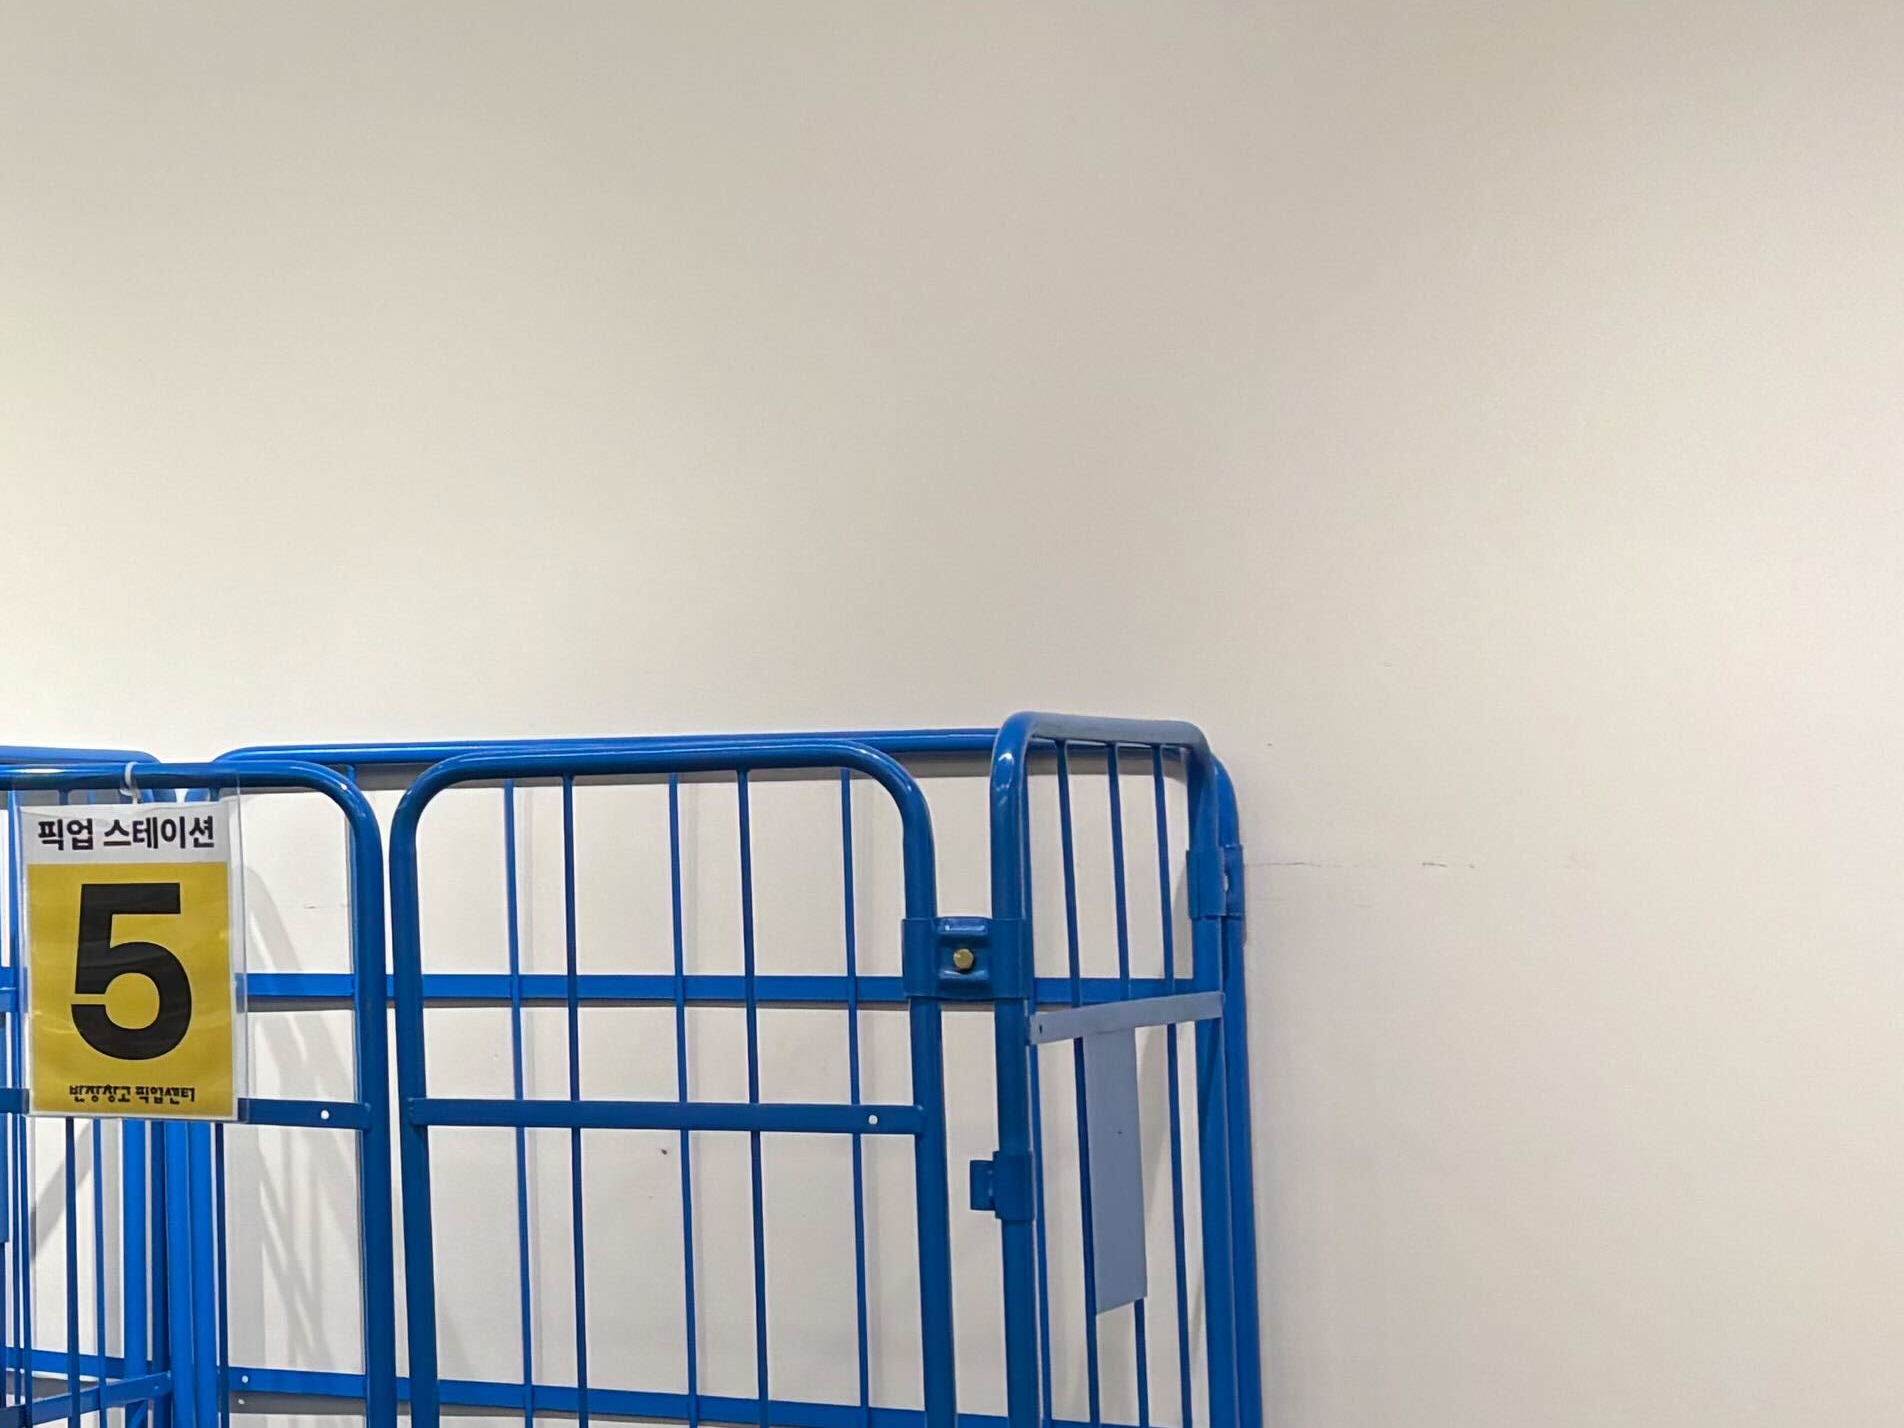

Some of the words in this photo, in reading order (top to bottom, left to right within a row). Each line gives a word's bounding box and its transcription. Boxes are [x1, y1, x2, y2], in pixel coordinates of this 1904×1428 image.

[38, 818, 94, 851] 픽업
[103, 815, 214, 849] 스테이션
[71, 882, 192, 1061] 5
